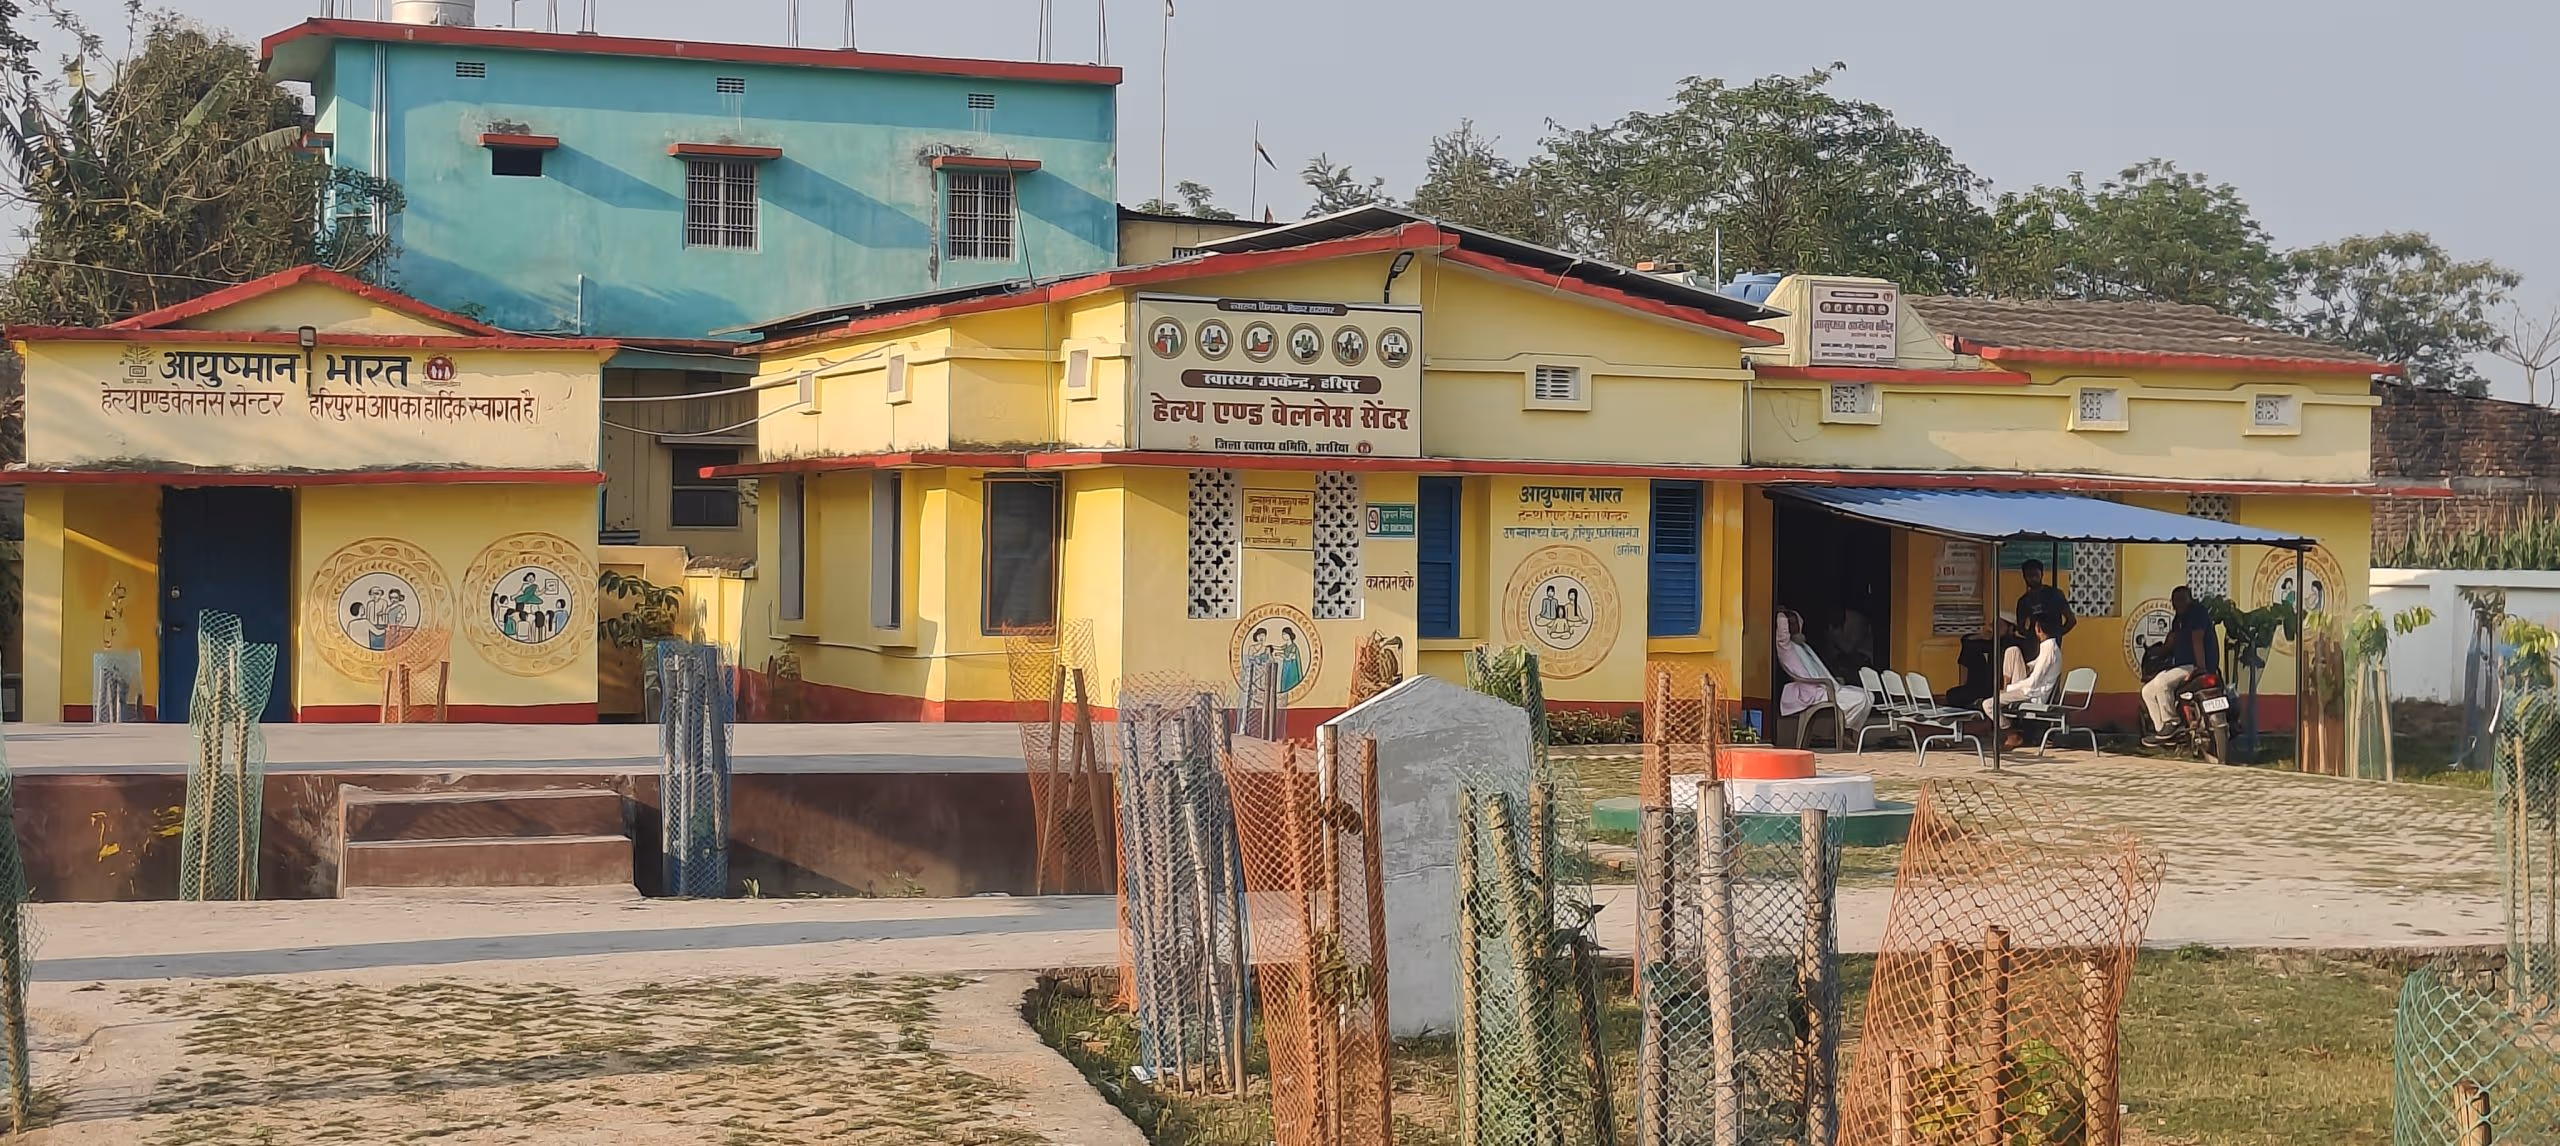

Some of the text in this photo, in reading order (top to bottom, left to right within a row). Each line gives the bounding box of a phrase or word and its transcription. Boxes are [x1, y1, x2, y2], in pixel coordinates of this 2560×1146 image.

[159, 351, 412, 388] आयुष्मान भारत
[1203, 373, 1255, 387] स्वास्थ्य
[1320, 375, 1362, 393] हरिपुर
[101, 382, 138, 416] हेल्थ
[169, 382, 226, 416] वेलनेस
[230, 384, 285, 416] सेन्टर
[309, 387, 353, 421] हरिपुर
[423, 389, 468, 424] हार्दिक
[468, 396, 522, 423] स्वागत
[1151, 392, 1411, 431] हेल्थ एण्ड वेलनेस सेंटर
[1215, 438, 1241, 450] जिला
[1244, 441, 1275, 451] स्वास्थ्य
[1315, 441, 1349, 453] अररिया
[1519, 486, 1623, 508] आयुष्मान भारत
